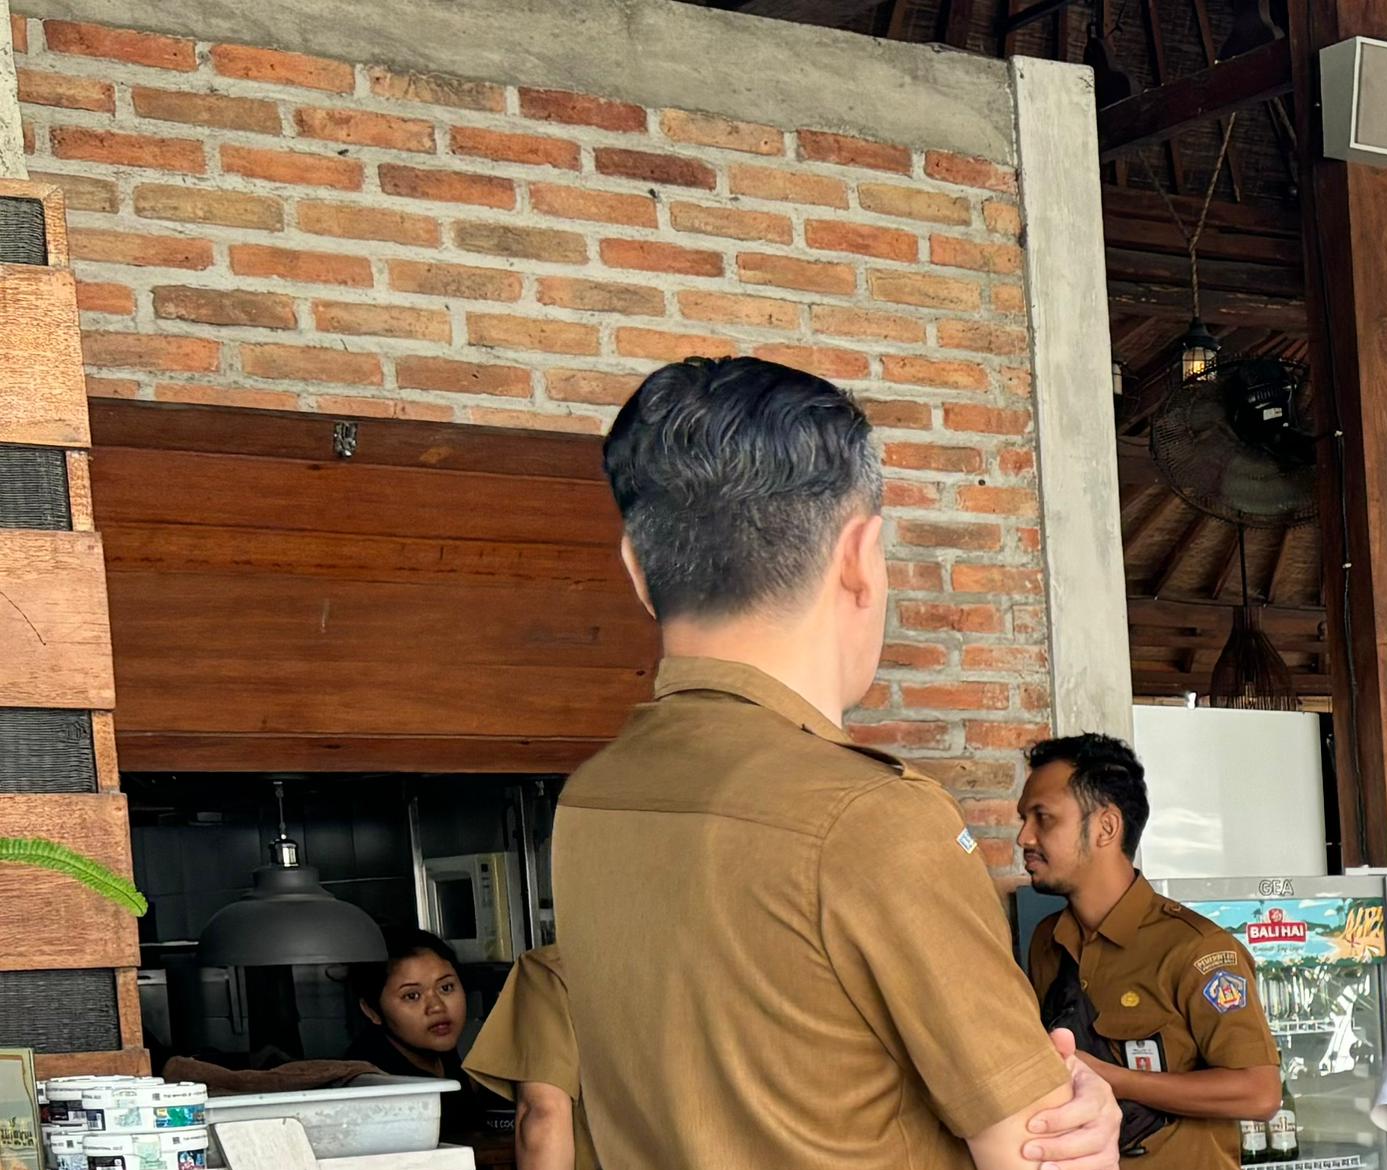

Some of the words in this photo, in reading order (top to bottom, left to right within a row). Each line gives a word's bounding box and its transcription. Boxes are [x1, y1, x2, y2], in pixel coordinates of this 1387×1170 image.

[1259, 879, 1294, 896] GEA
[1250, 926, 1279, 938] BALI
[1281, 925, 1304, 937] HAI
